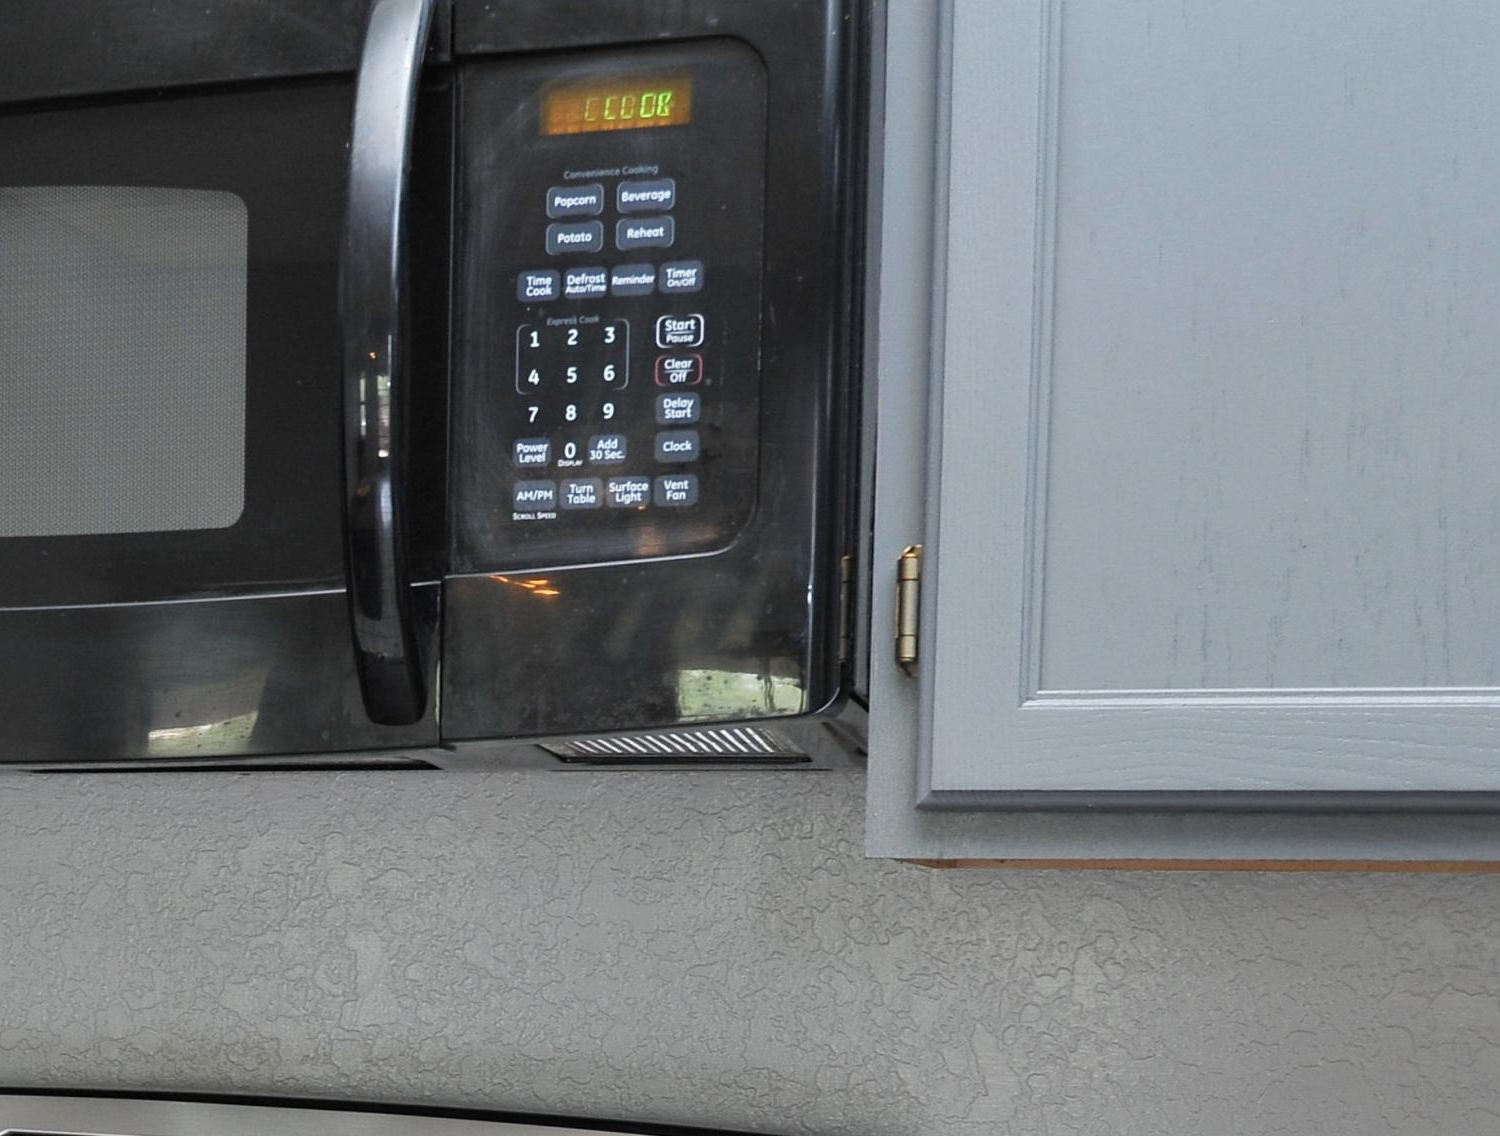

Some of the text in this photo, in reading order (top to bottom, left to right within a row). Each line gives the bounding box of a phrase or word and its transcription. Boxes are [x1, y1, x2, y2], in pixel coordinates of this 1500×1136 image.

[564, 164, 659, 179] Convenience Cooking
[554, 194, 596, 208] Popcorn
[621, 189, 671, 203] Beverage
[557, 231, 592, 244] Potato
[627, 227, 664, 240] Reheat
[666, 268, 697, 278] Timer
[526, 275, 552, 286] Time
[567, 274, 605, 285] Defrost
[612, 274, 655, 286] Reminder
[667, 277, 696, 288] On/Off
[526, 286, 552, 296] Cook
[565, 284, 606, 294] Auto/Time
[665, 319, 696, 331] Start
[530, 327, 615, 347] 1 2 3
[666, 333, 694, 343] Pause
[664, 359, 692, 370] Clear
[528, 364, 615, 385] 4 5 6
[670, 371, 688, 383] Off
[664, 398, 694, 410] Delay
[528, 403, 615, 423] 7 8 9
[665, 409, 692, 419] Start
[516, 443, 548, 453] Power
[597, 438, 618, 449] Add
[663, 441, 692, 451] Clock
[564, 443, 576, 458] 0
[590, 449, 625, 460] 30 Sec.
[519, 452, 546, 463] Level
[569, 484, 593, 494] Turn
[609, 481, 649, 493] Surface
[664, 480, 689, 490] Vent
[516, 489, 553, 501] AM/PM
[567, 493, 596, 504] Table
[615, 491, 642, 504] Light
[666, 490, 686, 501] Fan
